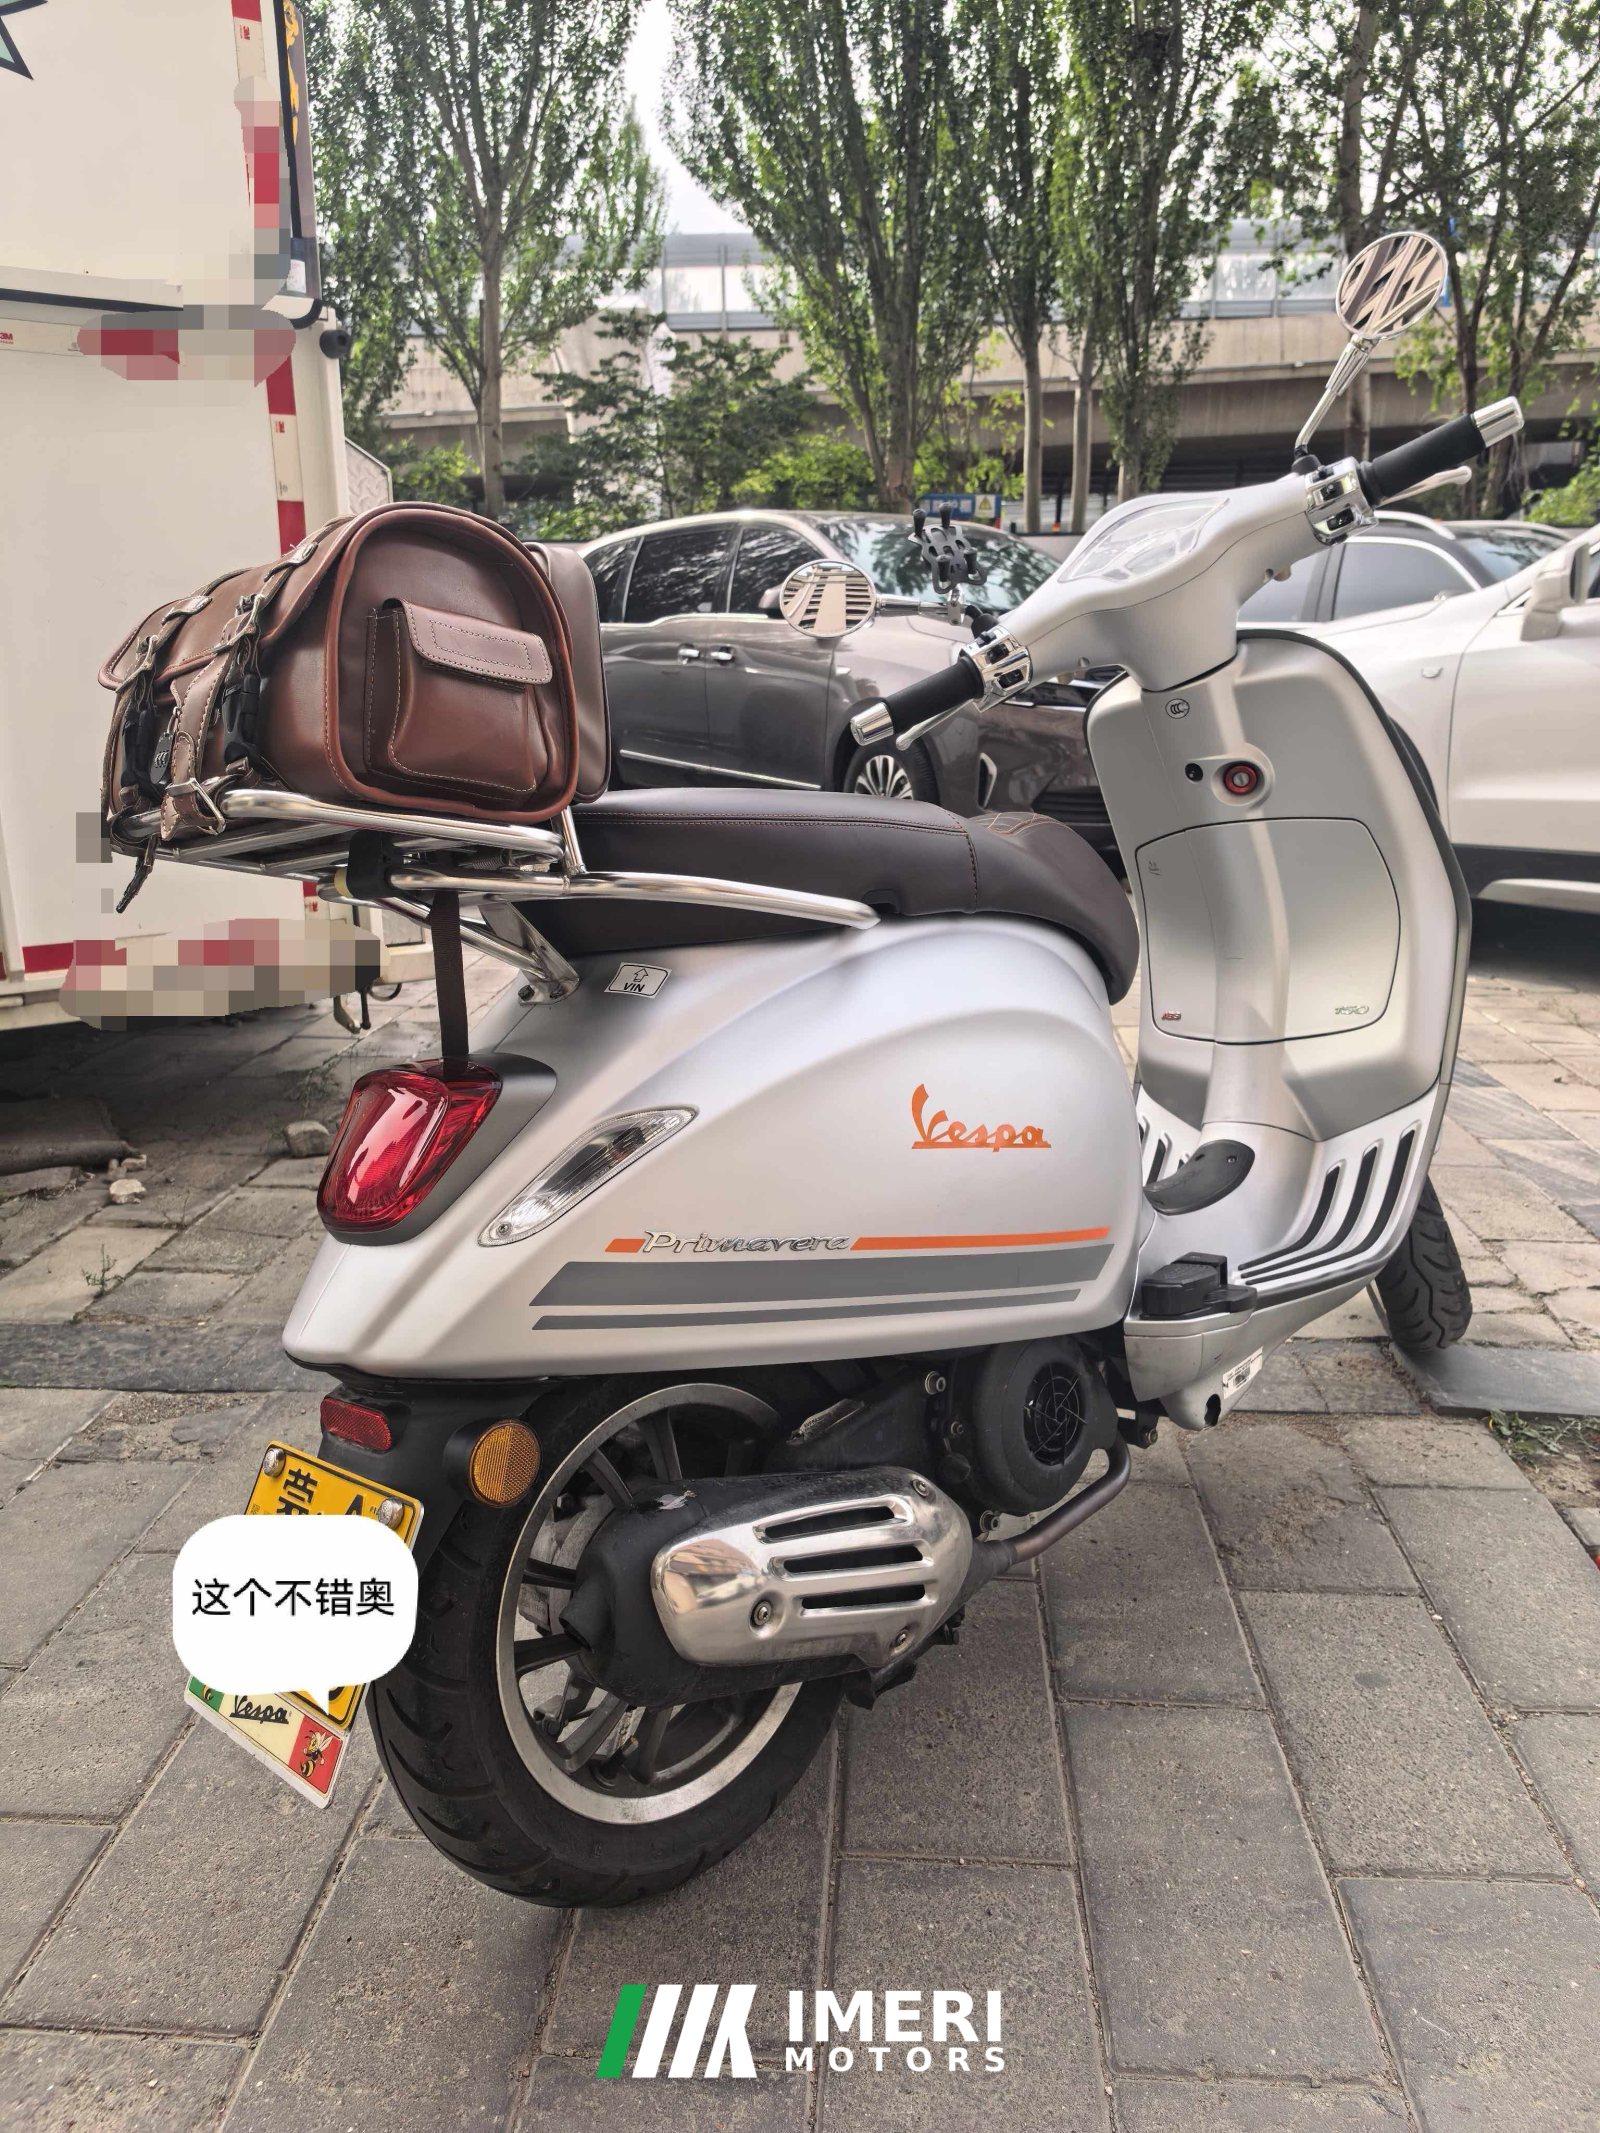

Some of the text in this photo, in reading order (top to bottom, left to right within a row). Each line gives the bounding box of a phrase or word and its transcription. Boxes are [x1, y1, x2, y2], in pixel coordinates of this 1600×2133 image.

[623, 982, 645, 993] VIN
[911, 1083, 1052, 1152] Vespa
[642, 1230, 849, 1253] Primavera
[229, 1695, 289, 1724] Vespa
